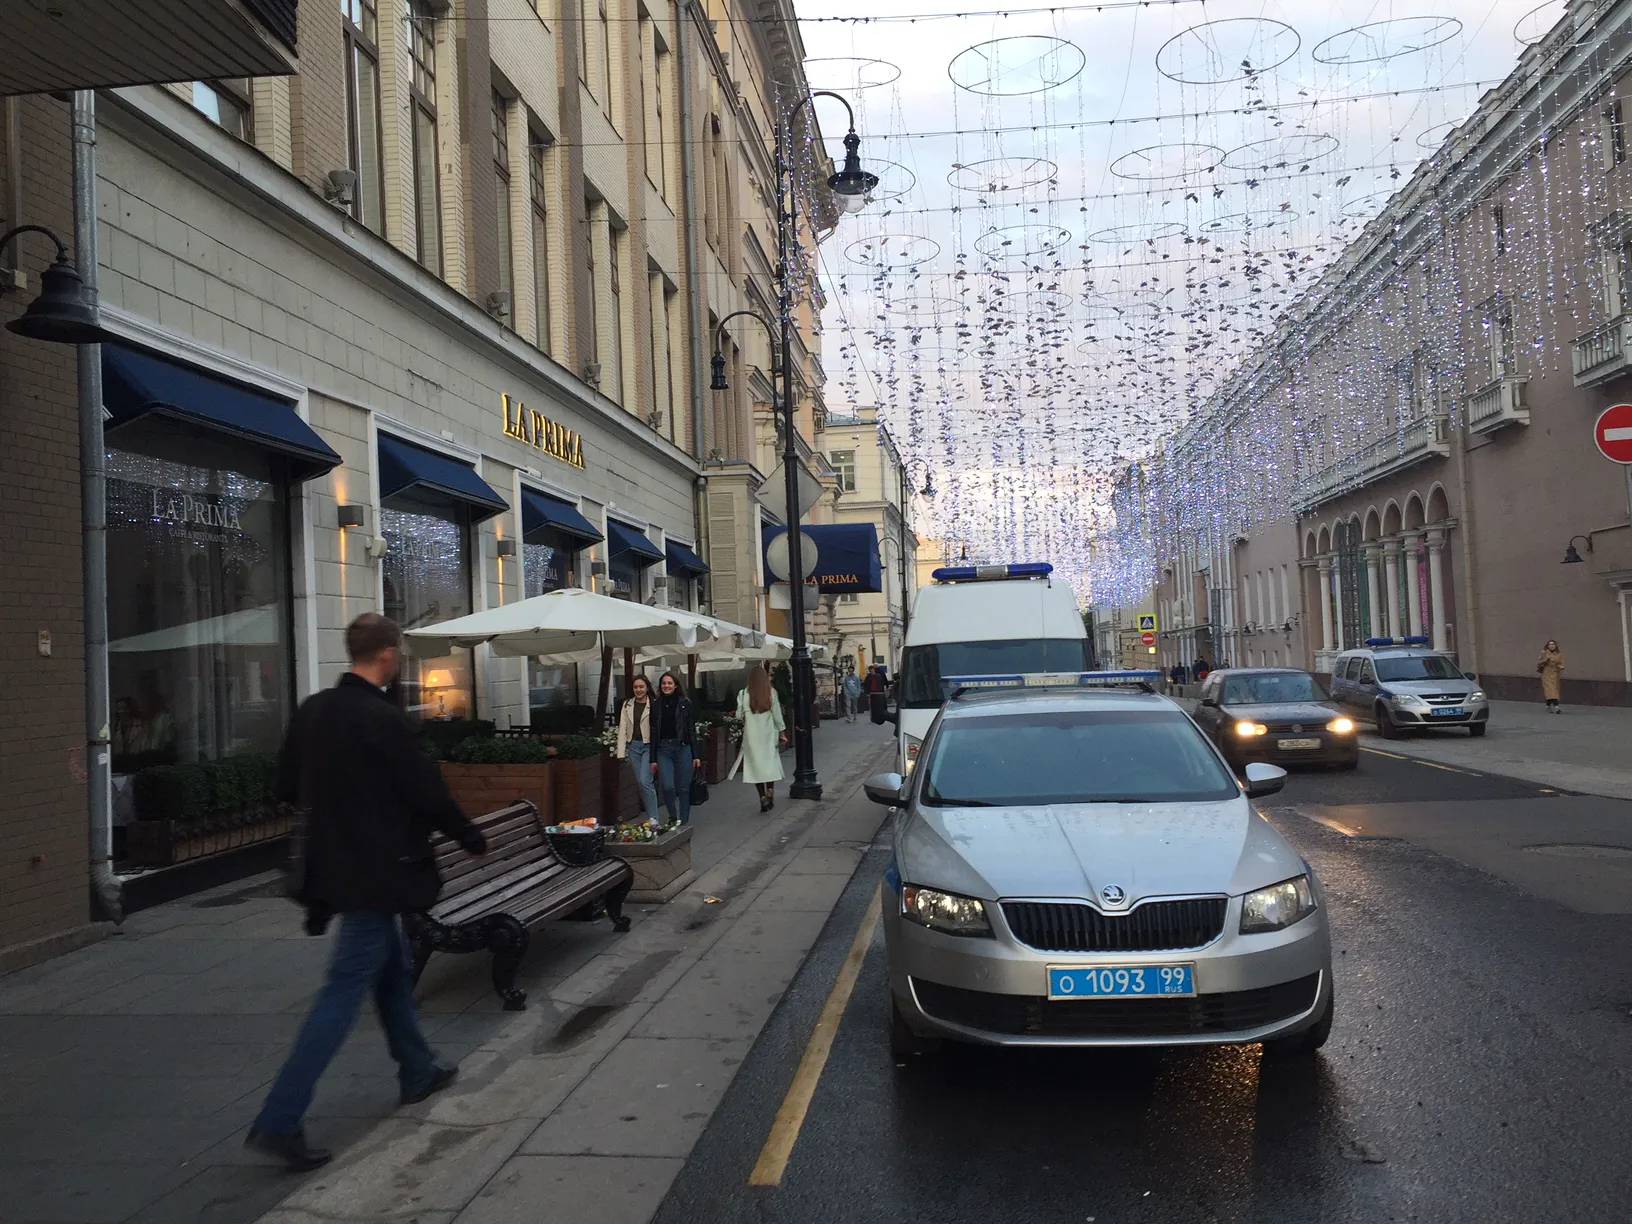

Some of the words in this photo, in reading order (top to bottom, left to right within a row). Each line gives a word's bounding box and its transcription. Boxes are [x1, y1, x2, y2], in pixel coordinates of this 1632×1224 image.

[502, 393, 530, 444] LA
[531, 409, 586, 470] PRIMA
[151, 488, 179, 520] LA
[183, 495, 242, 530] PRIMA
[803, 576, 819, 585] LA
[821, 574, 858, 584] PRIMA
[1086, 969, 1146, 993] 1093
[1160, 967, 1185, 985] 99
[1165, 985, 1183, 993] RUS
